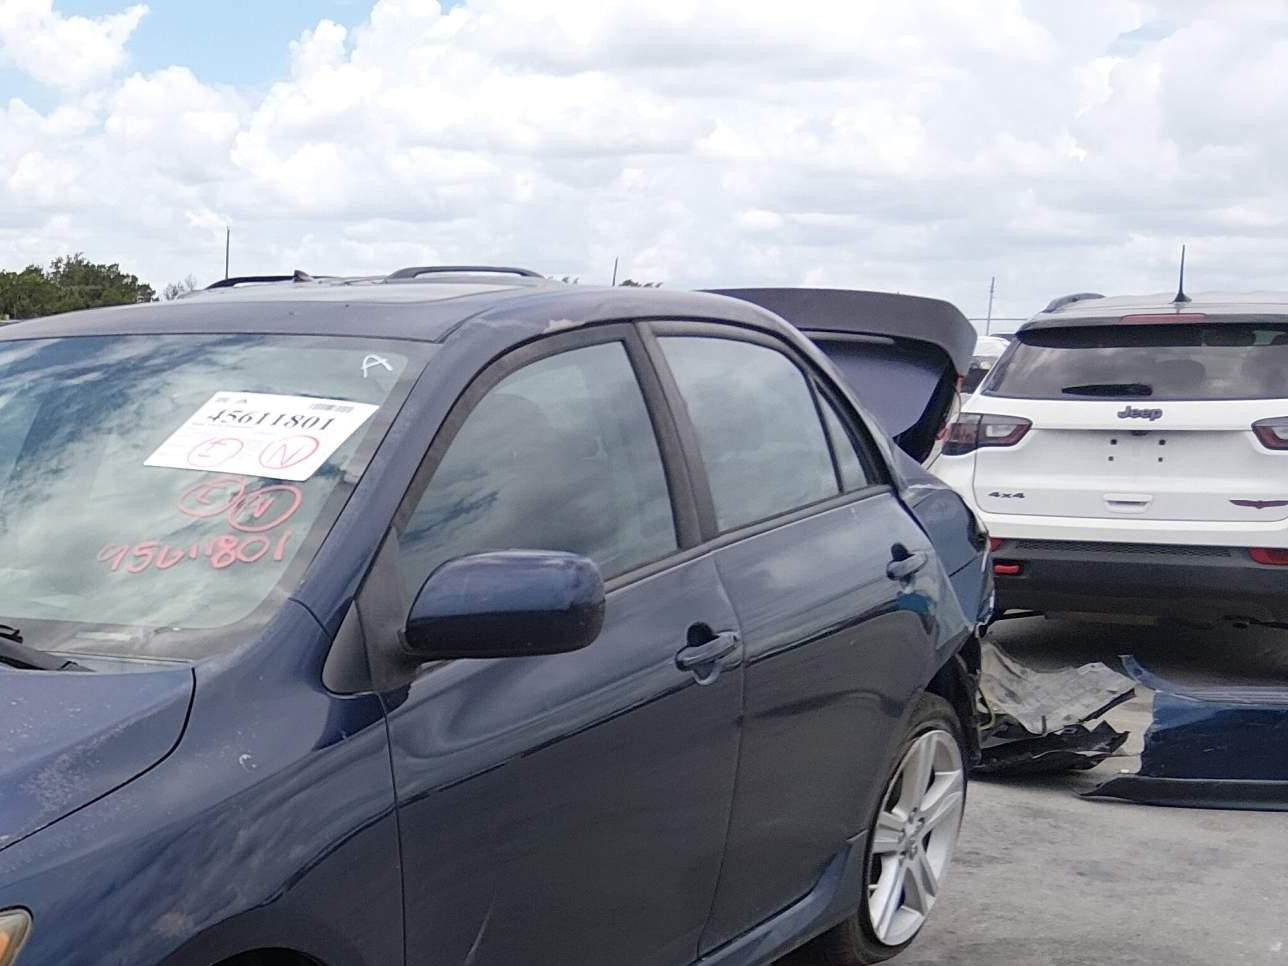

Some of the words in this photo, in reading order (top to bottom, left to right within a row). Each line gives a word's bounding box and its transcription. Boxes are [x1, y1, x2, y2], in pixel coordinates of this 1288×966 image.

[207, 408, 336, 432] 45611801
[1117, 405, 1163, 422] Jeep
[987, 491, 1026, 499] 4x4
